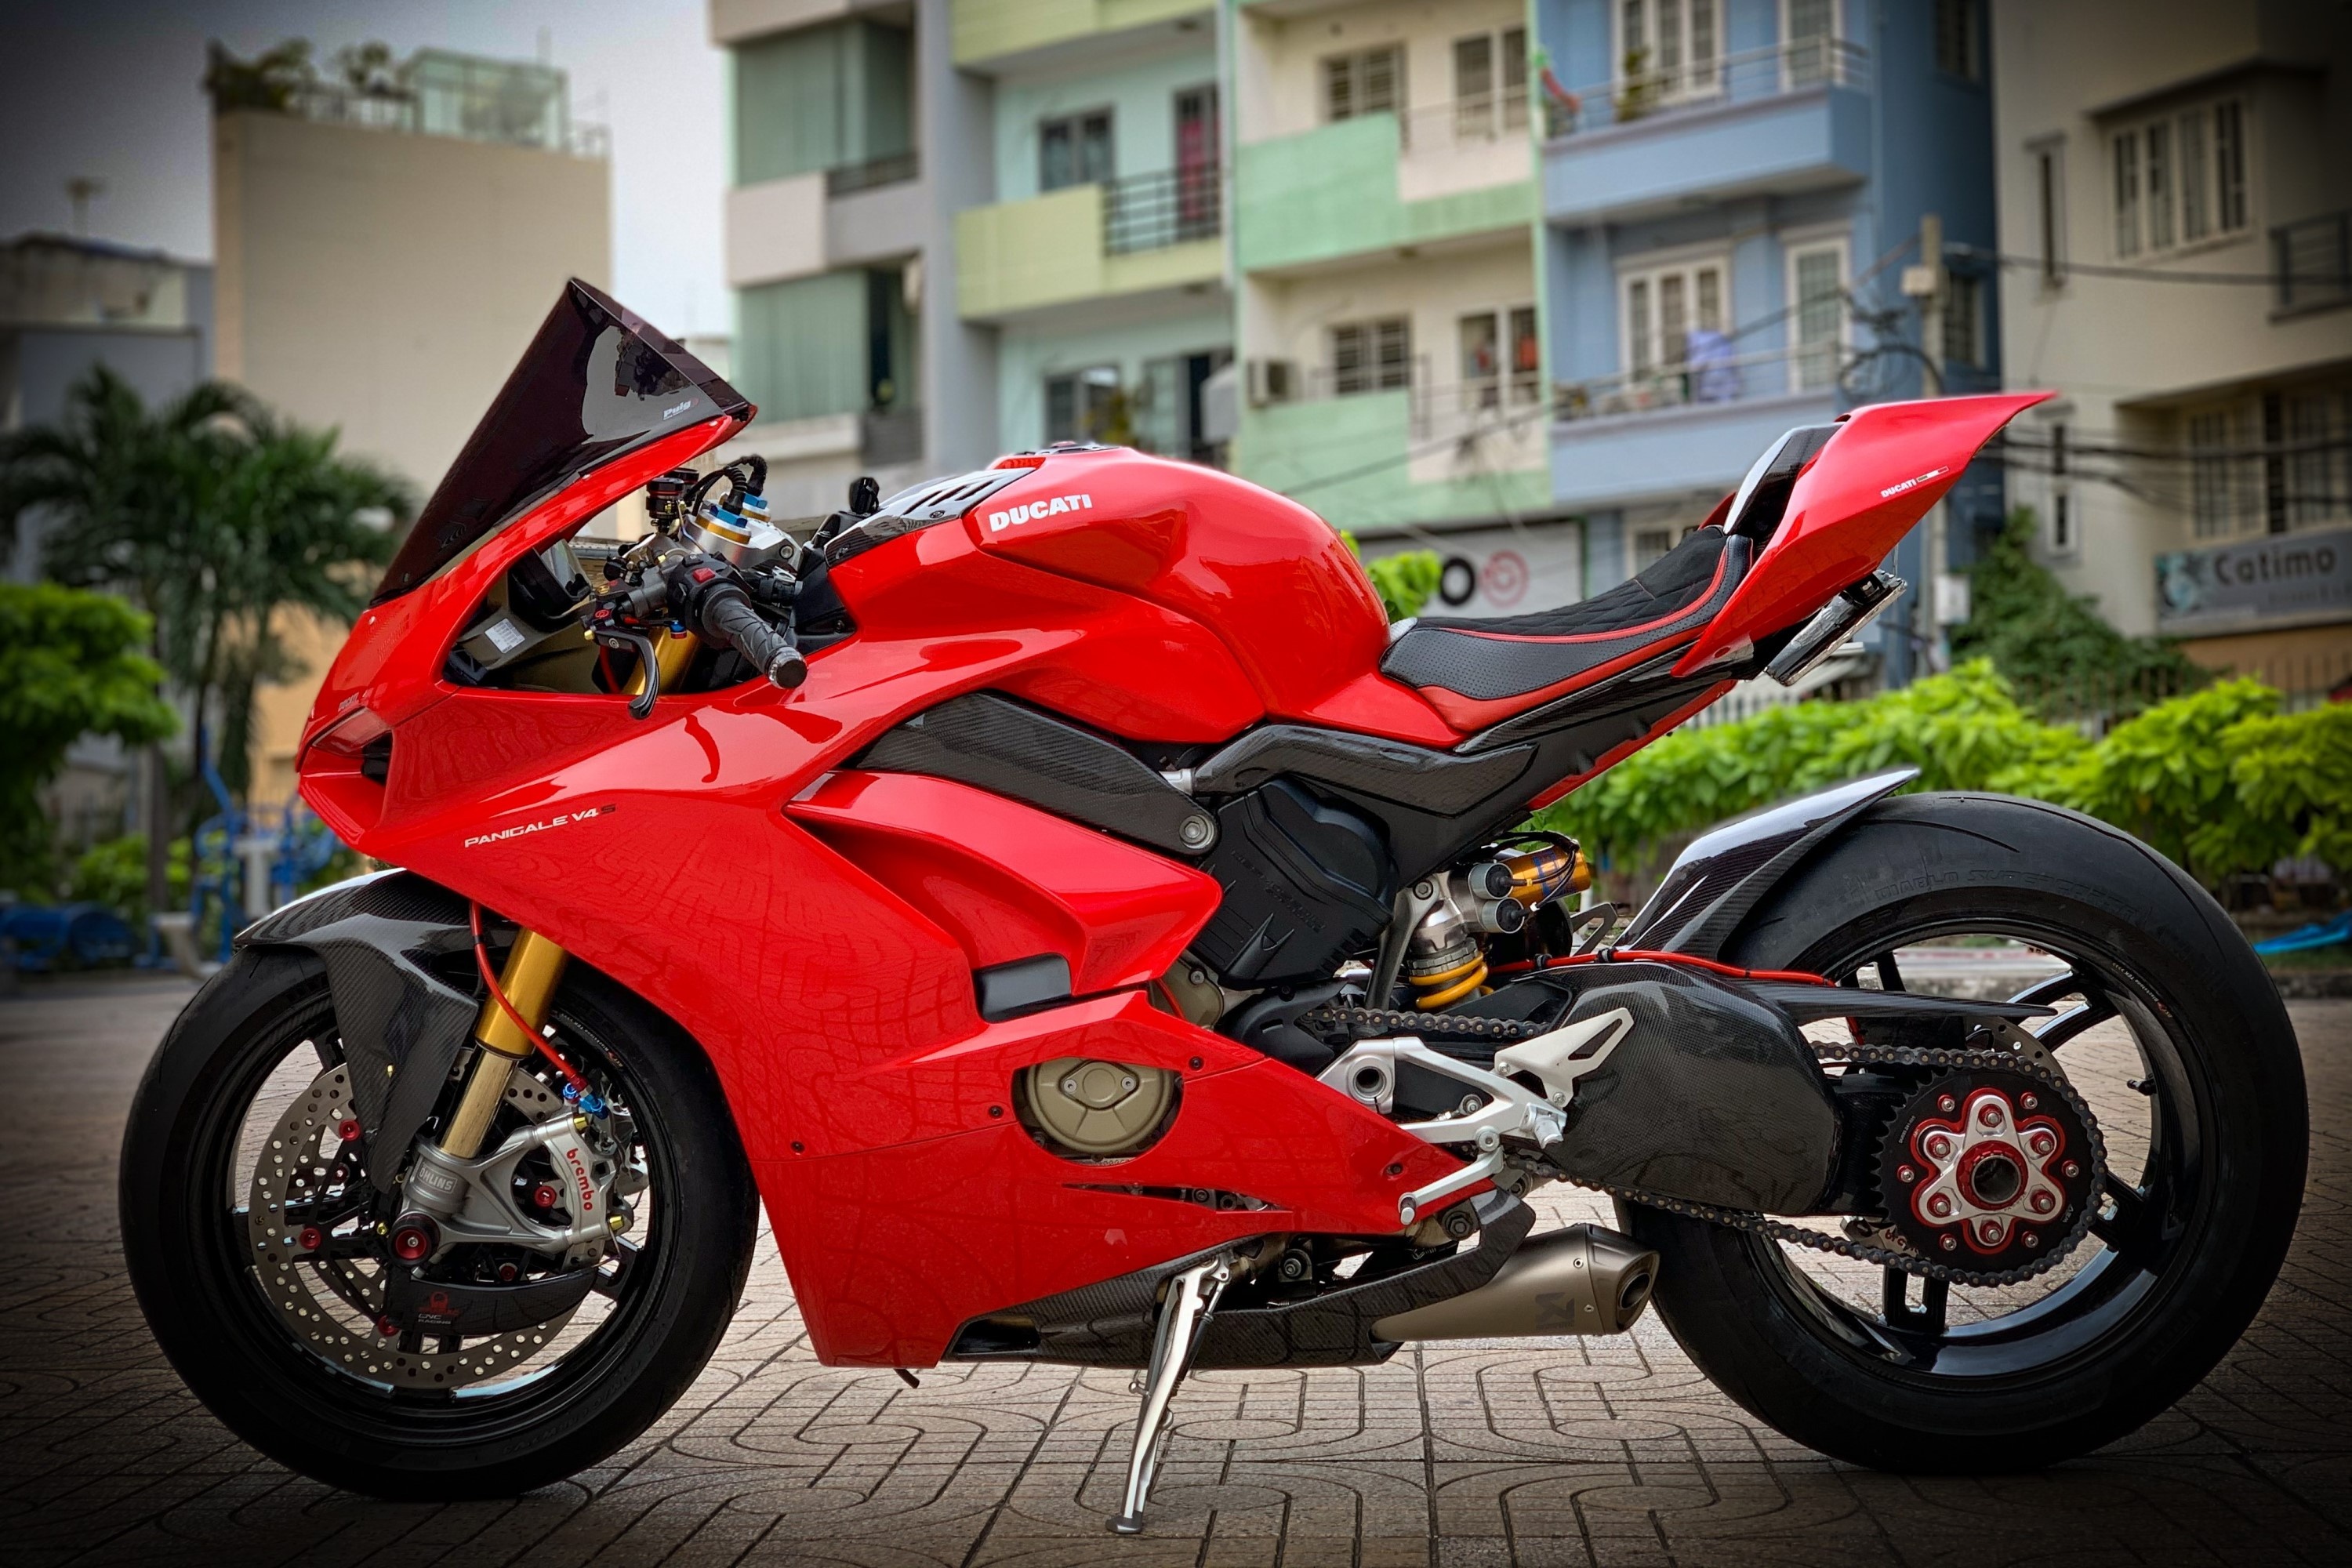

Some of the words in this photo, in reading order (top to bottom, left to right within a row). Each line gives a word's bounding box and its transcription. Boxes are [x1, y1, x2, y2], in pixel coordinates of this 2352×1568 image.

[1880, 478, 1917, 498] DUCATI
[989, 494, 1093, 532] DUCATI
[464, 815, 568, 848] PANIGALE
[1875, 871, 1959, 901] DIABLO
[566, 1148, 595, 1210] brembo
